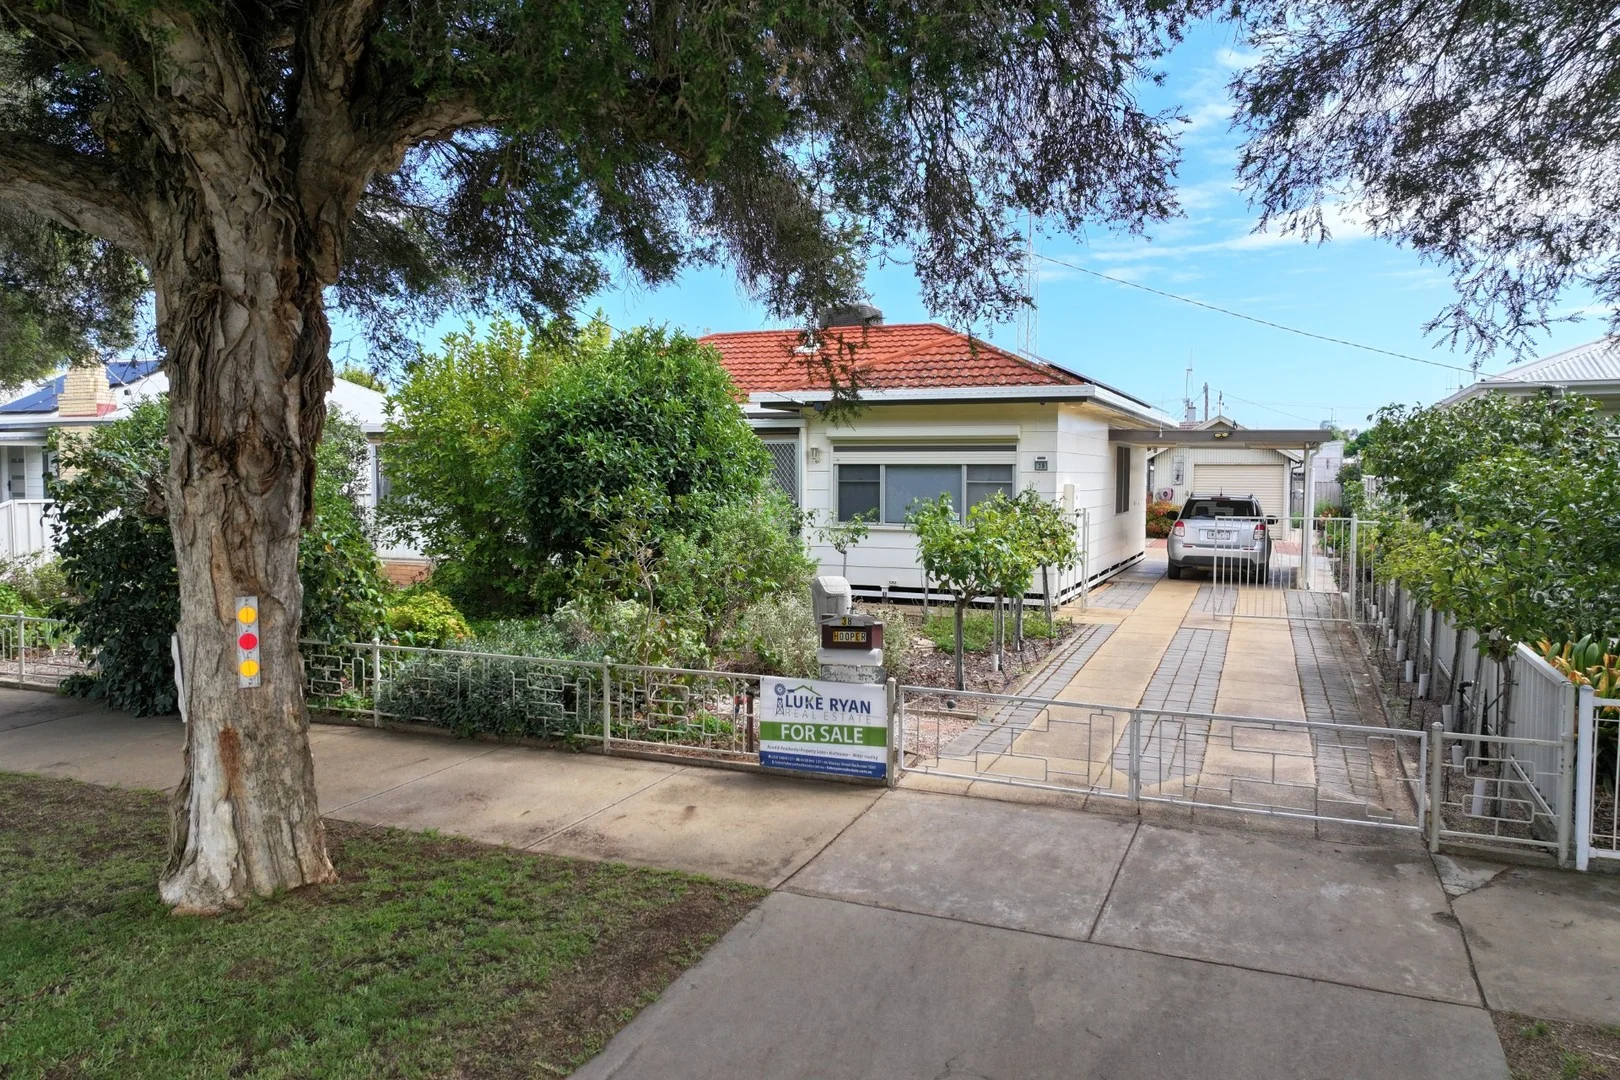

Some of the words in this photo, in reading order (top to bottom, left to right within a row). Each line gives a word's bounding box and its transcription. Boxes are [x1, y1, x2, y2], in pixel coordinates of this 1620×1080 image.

[841, 616, 852, 626] 38
[833, 632, 866, 641] HOOPER
[785, 695, 823, 710] LUKE
[829, 698, 871, 714] RYAN
[785, 709, 816, 720] REAL
[823, 711, 871, 725] ESTATE
[781, 724, 815, 741] FOR
[820, 726, 864, 744] SALE
